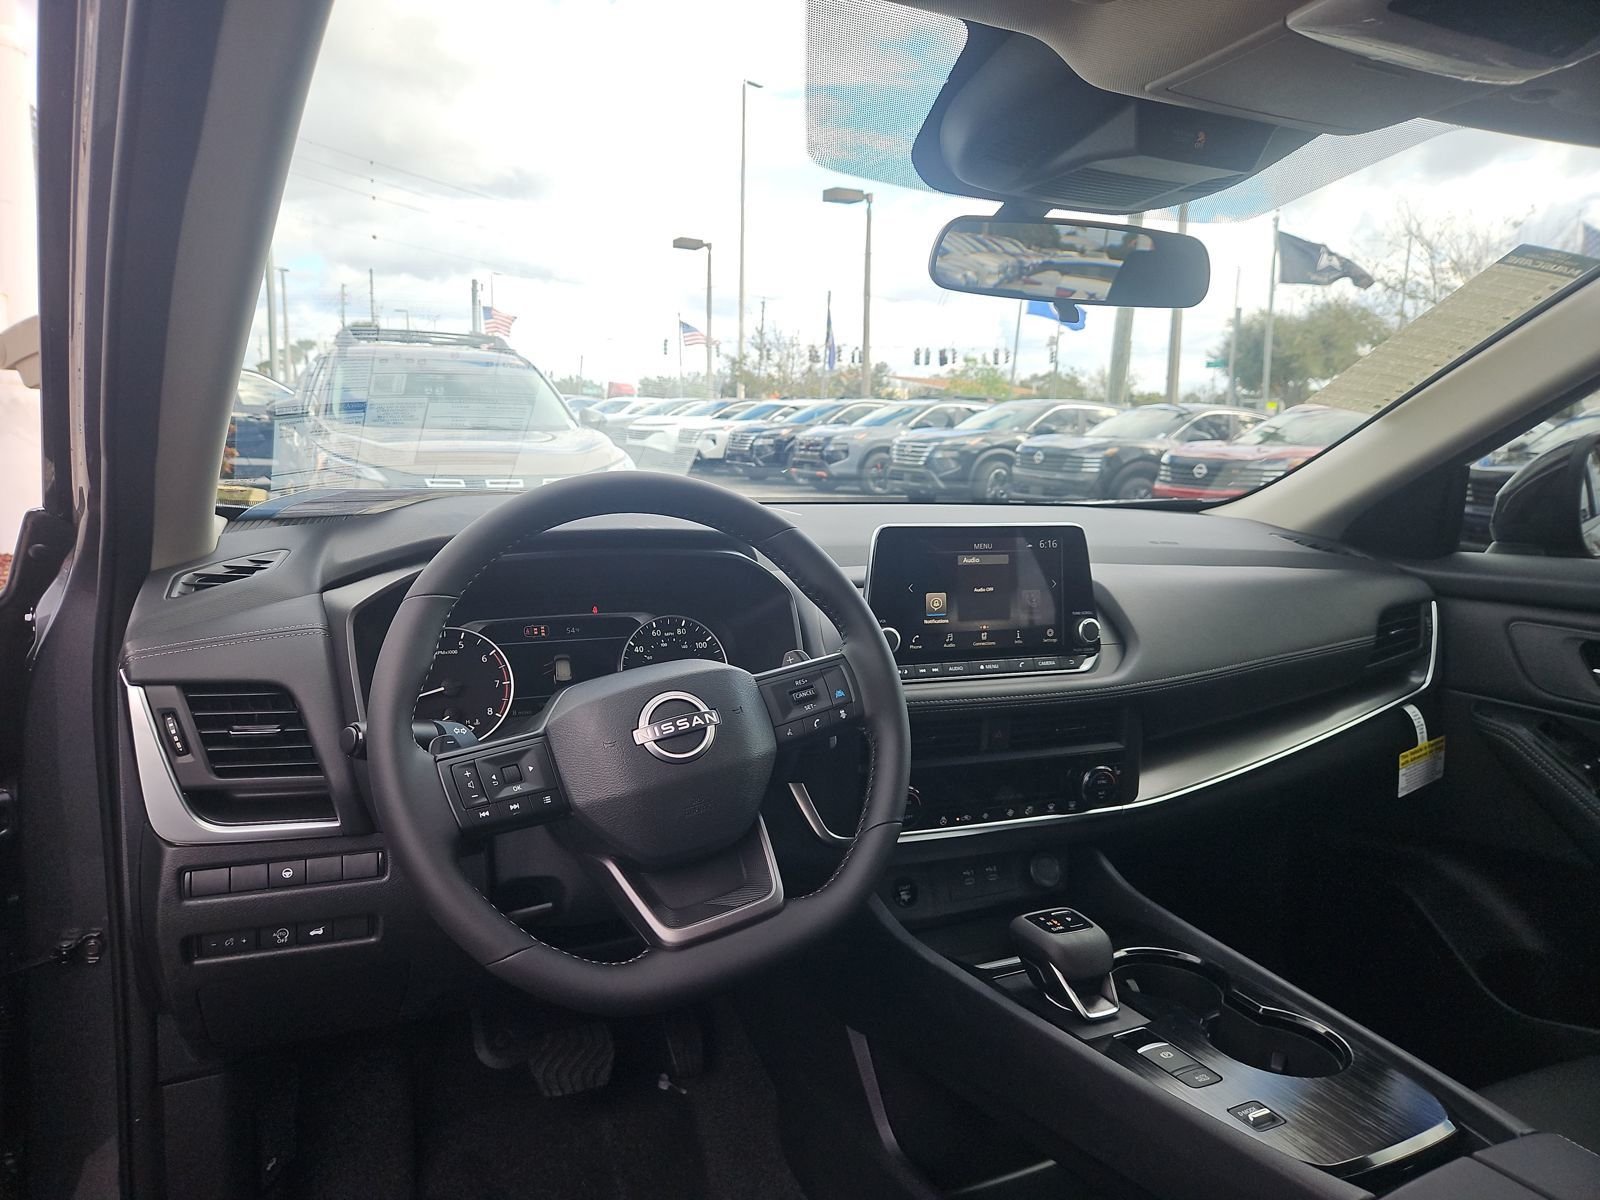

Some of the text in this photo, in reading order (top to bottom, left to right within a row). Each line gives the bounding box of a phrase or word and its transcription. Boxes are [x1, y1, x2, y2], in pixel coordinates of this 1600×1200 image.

[1039, 539, 1058, 549] 6:16
[651, 629, 662, 637] 60
[458, 641, 465, 649] 5
[634, 645, 644, 653] 40
[695, 641, 708, 649] 100
[481, 654, 488, 663] 6
[494, 680, 500, 688] 7
[795, 689, 816, 699] CANCEL
[487, 707, 494, 716] 8
[637, 710, 718, 741] NISSAN
[512, 784, 522, 792] OK
